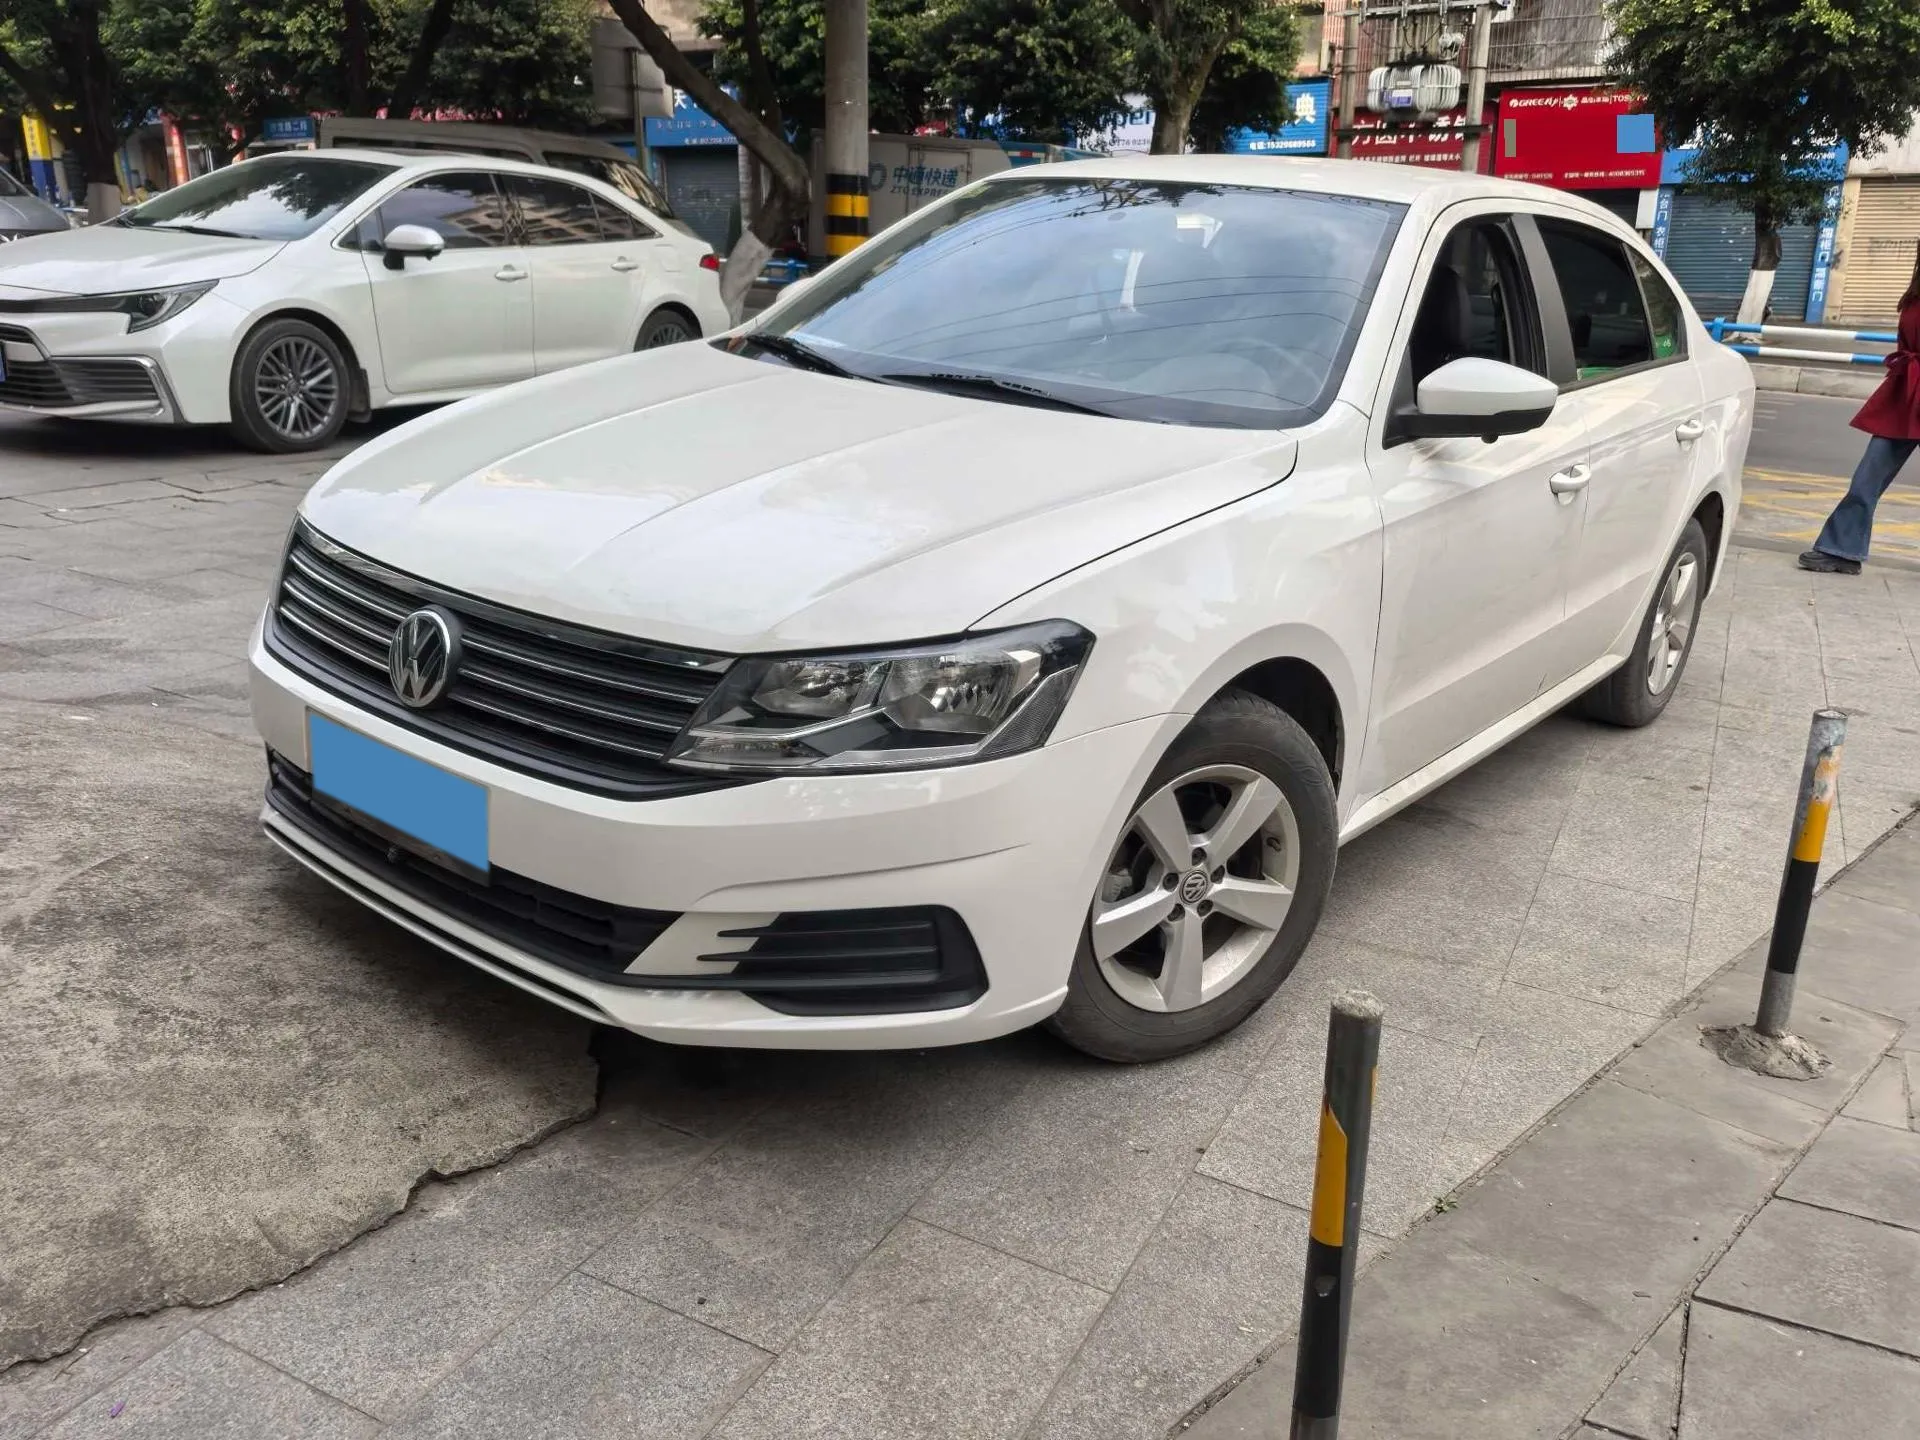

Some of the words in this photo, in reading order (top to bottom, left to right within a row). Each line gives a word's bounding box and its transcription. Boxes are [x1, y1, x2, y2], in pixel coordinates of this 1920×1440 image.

[892, 165, 958, 187] 中通快递
[890, 186, 909, 196] ZTO
